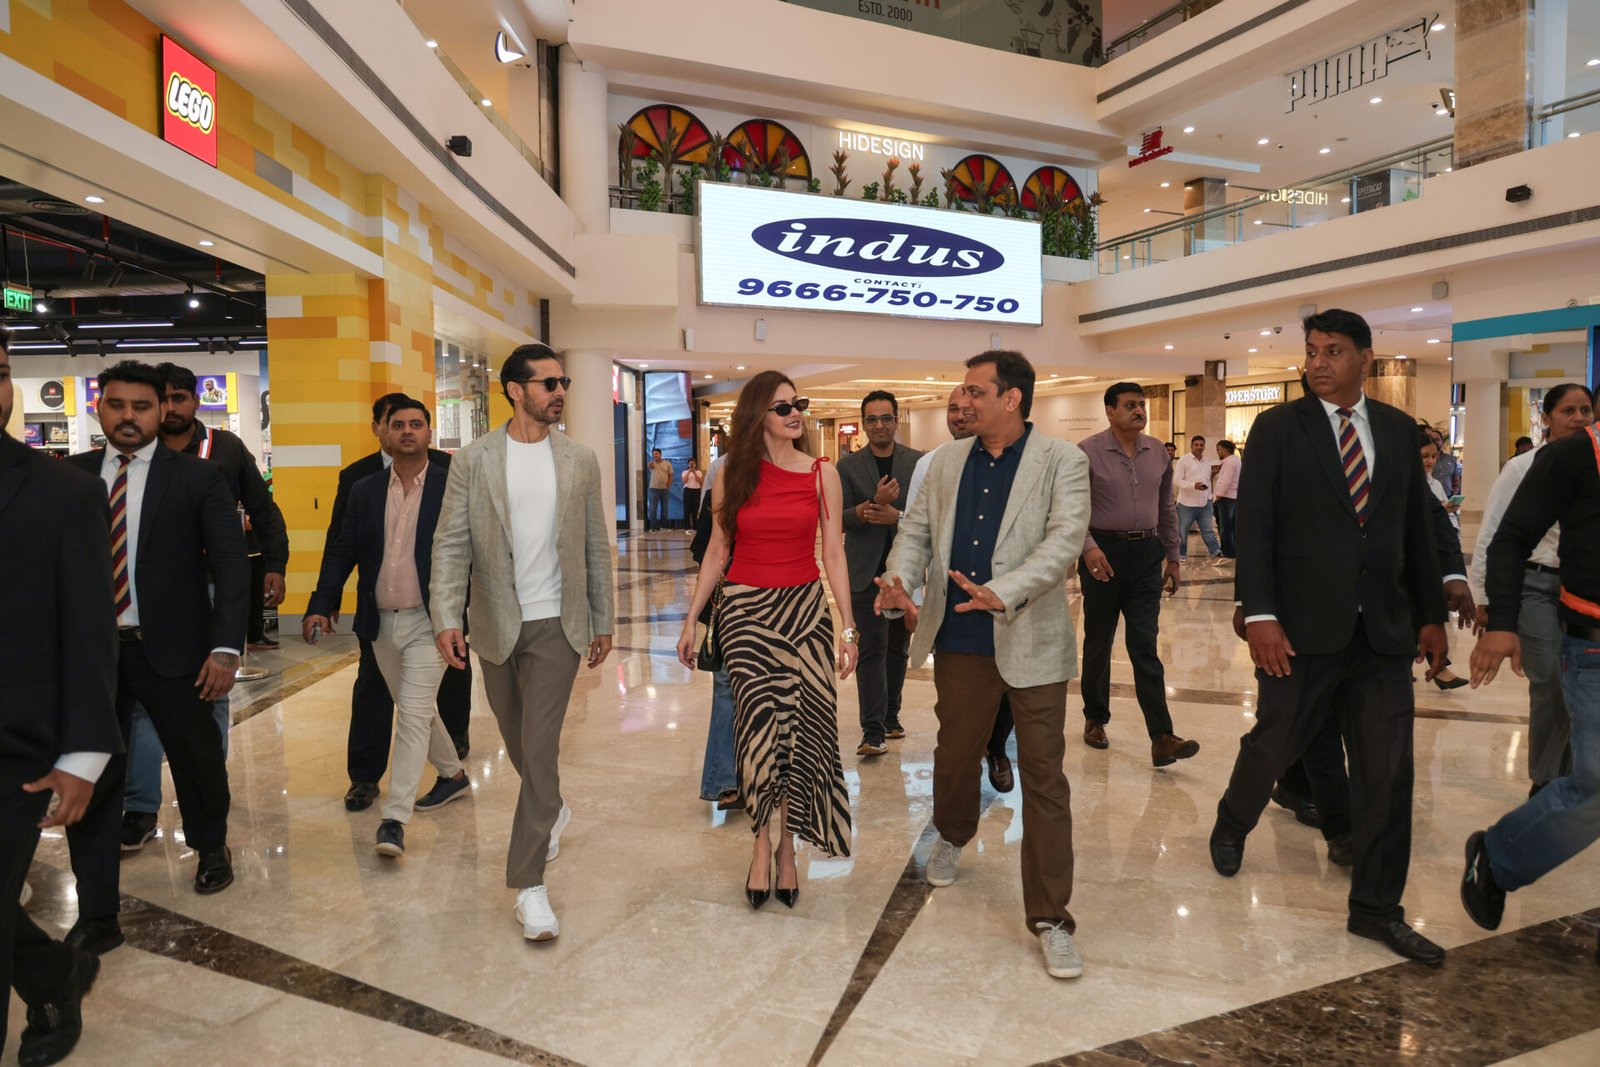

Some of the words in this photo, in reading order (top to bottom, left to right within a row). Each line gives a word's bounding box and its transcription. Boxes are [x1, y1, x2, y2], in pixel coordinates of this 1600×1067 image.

[858, 0, 885, 16] ESTD.
[887, 5, 913, 22] 2000
[167, 72, 214, 134] LEGO
[839, 131, 924, 161] HIDESIGN
[777, 222, 984, 269] indus
[737, 278, 1020, 314] 9666-750-750
[854, 278, 922, 288] CONTACT:
[6, 291, 30, 310] EXIT
